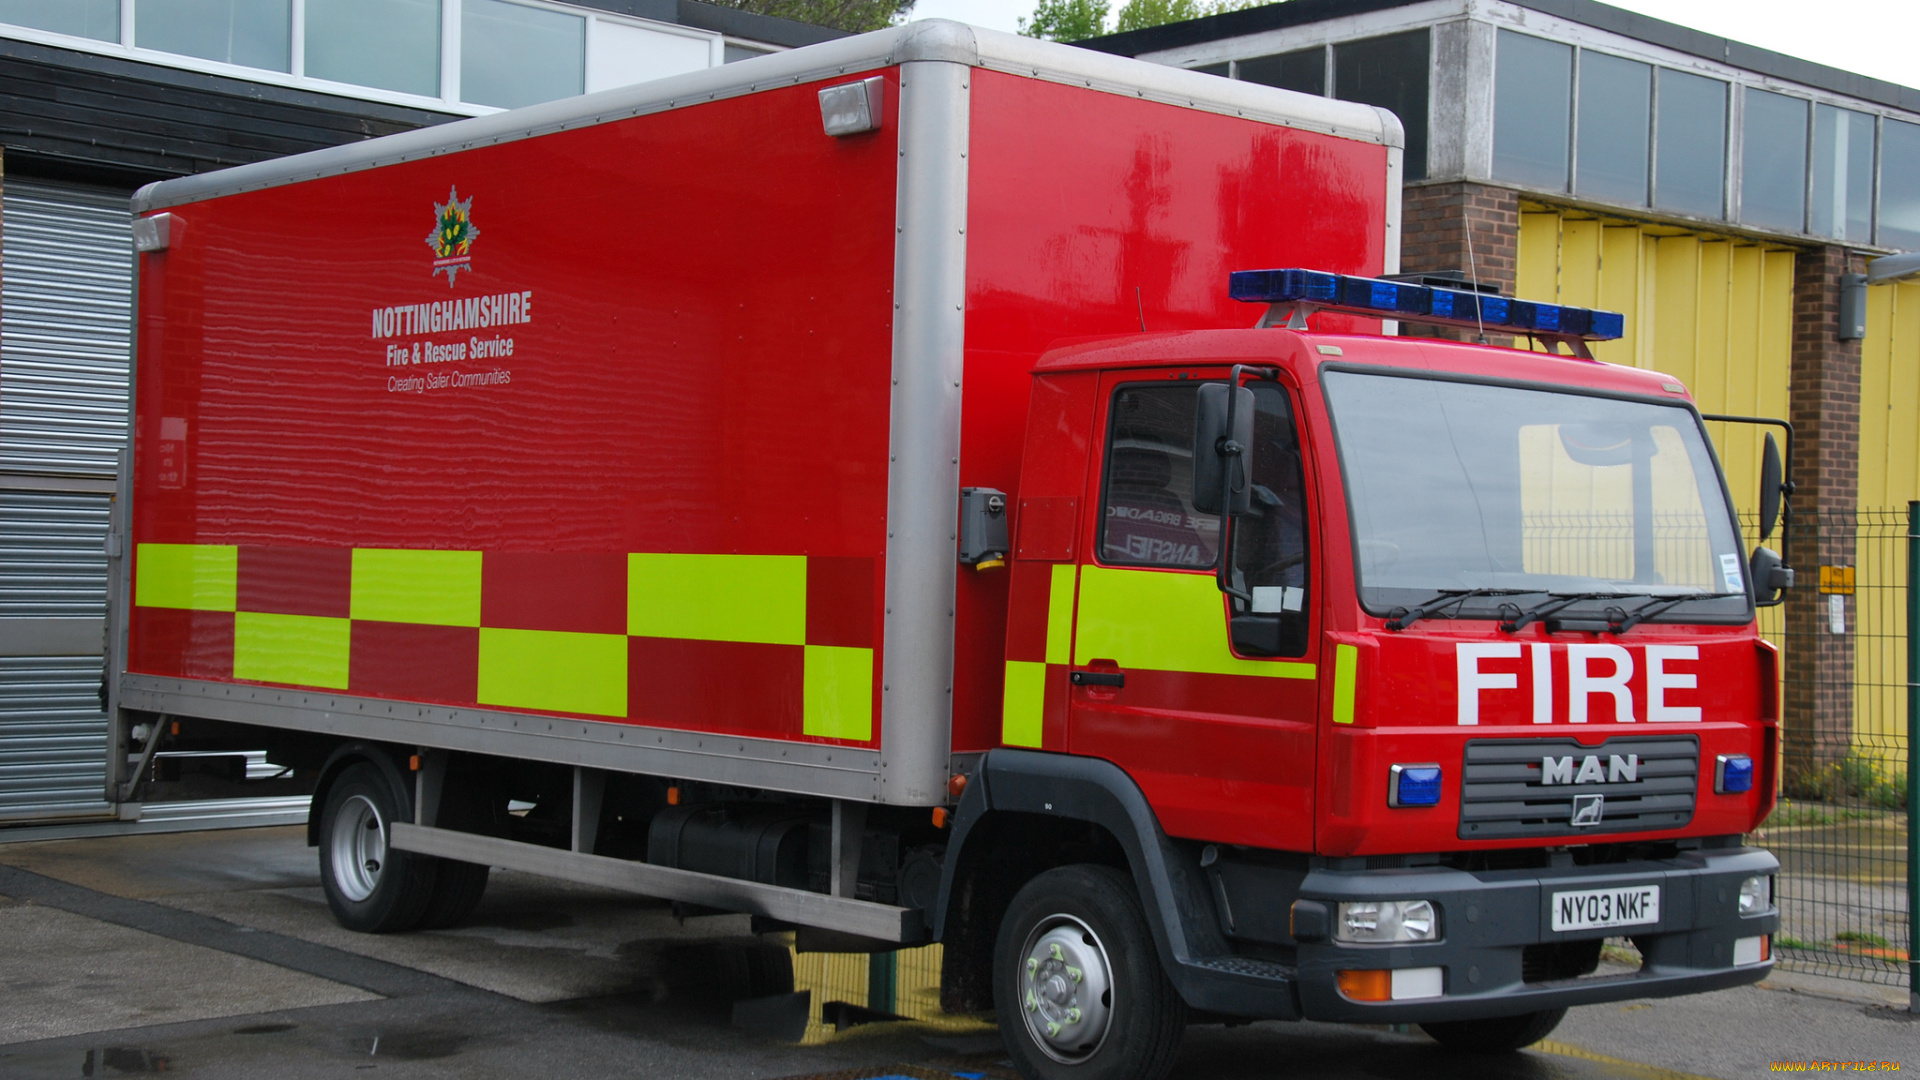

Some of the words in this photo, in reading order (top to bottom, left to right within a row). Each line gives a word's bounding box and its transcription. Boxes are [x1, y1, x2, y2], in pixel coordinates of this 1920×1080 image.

[372, 291, 532, 339] NOTTINGHAMSHIRE
[386, 344, 409, 367] Fire
[412, 342, 421, 365] &
[424, 341, 467, 363] Rescue
[469, 334, 514, 359] Service
[387, 374, 425, 394] Creating
[426, 372, 450, 389] Safer
[451, 368, 511, 388] Communities
[1456, 642, 1702, 726] FIRE
[1541, 754, 1638, 786] MAN
[1561, 894, 1611, 925] NY03
[1616, 891, 1651, 920] NKF
